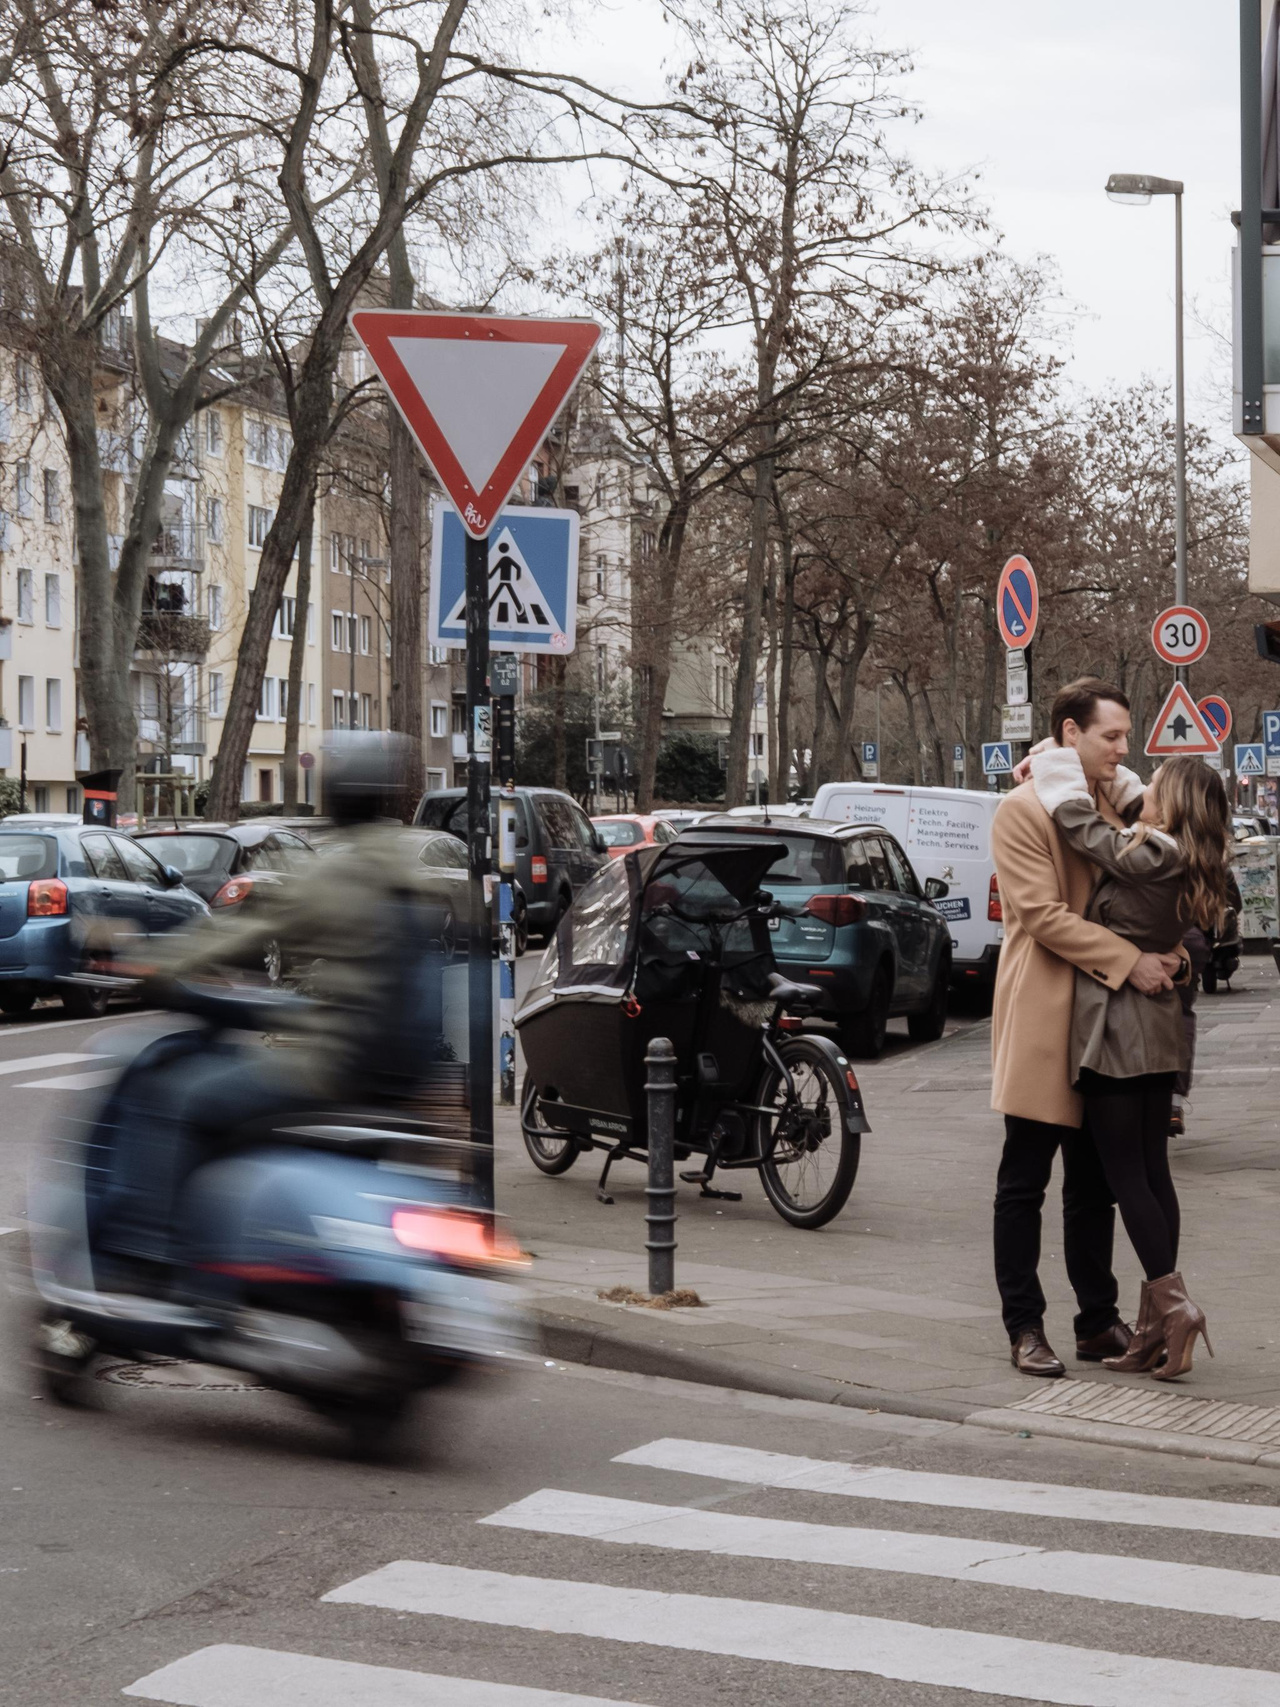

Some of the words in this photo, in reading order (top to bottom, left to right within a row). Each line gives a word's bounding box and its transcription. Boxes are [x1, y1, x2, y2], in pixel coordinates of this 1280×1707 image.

[1165, 622, 1197, 648] 30
[1266, 715, 1280, 742] P
[865, 745, 874, 760] P
[854, 805, 886, 814] Heizung
[919, 808, 948, 817] Elektro
[853, 814, 881, 822] Sanitär
[918, 818, 942, 827] Techn.
[946, 820, 980, 831] Facility-
[917, 828, 970, 840] Management
[917, 839, 942, 848] Techn.
[945, 841, 979, 850] Services
[935, 900, 964, 910] UCHEN
[589, 1118, 608, 1128] URBAN
[608, 1122, 627, 1133] ARROW
